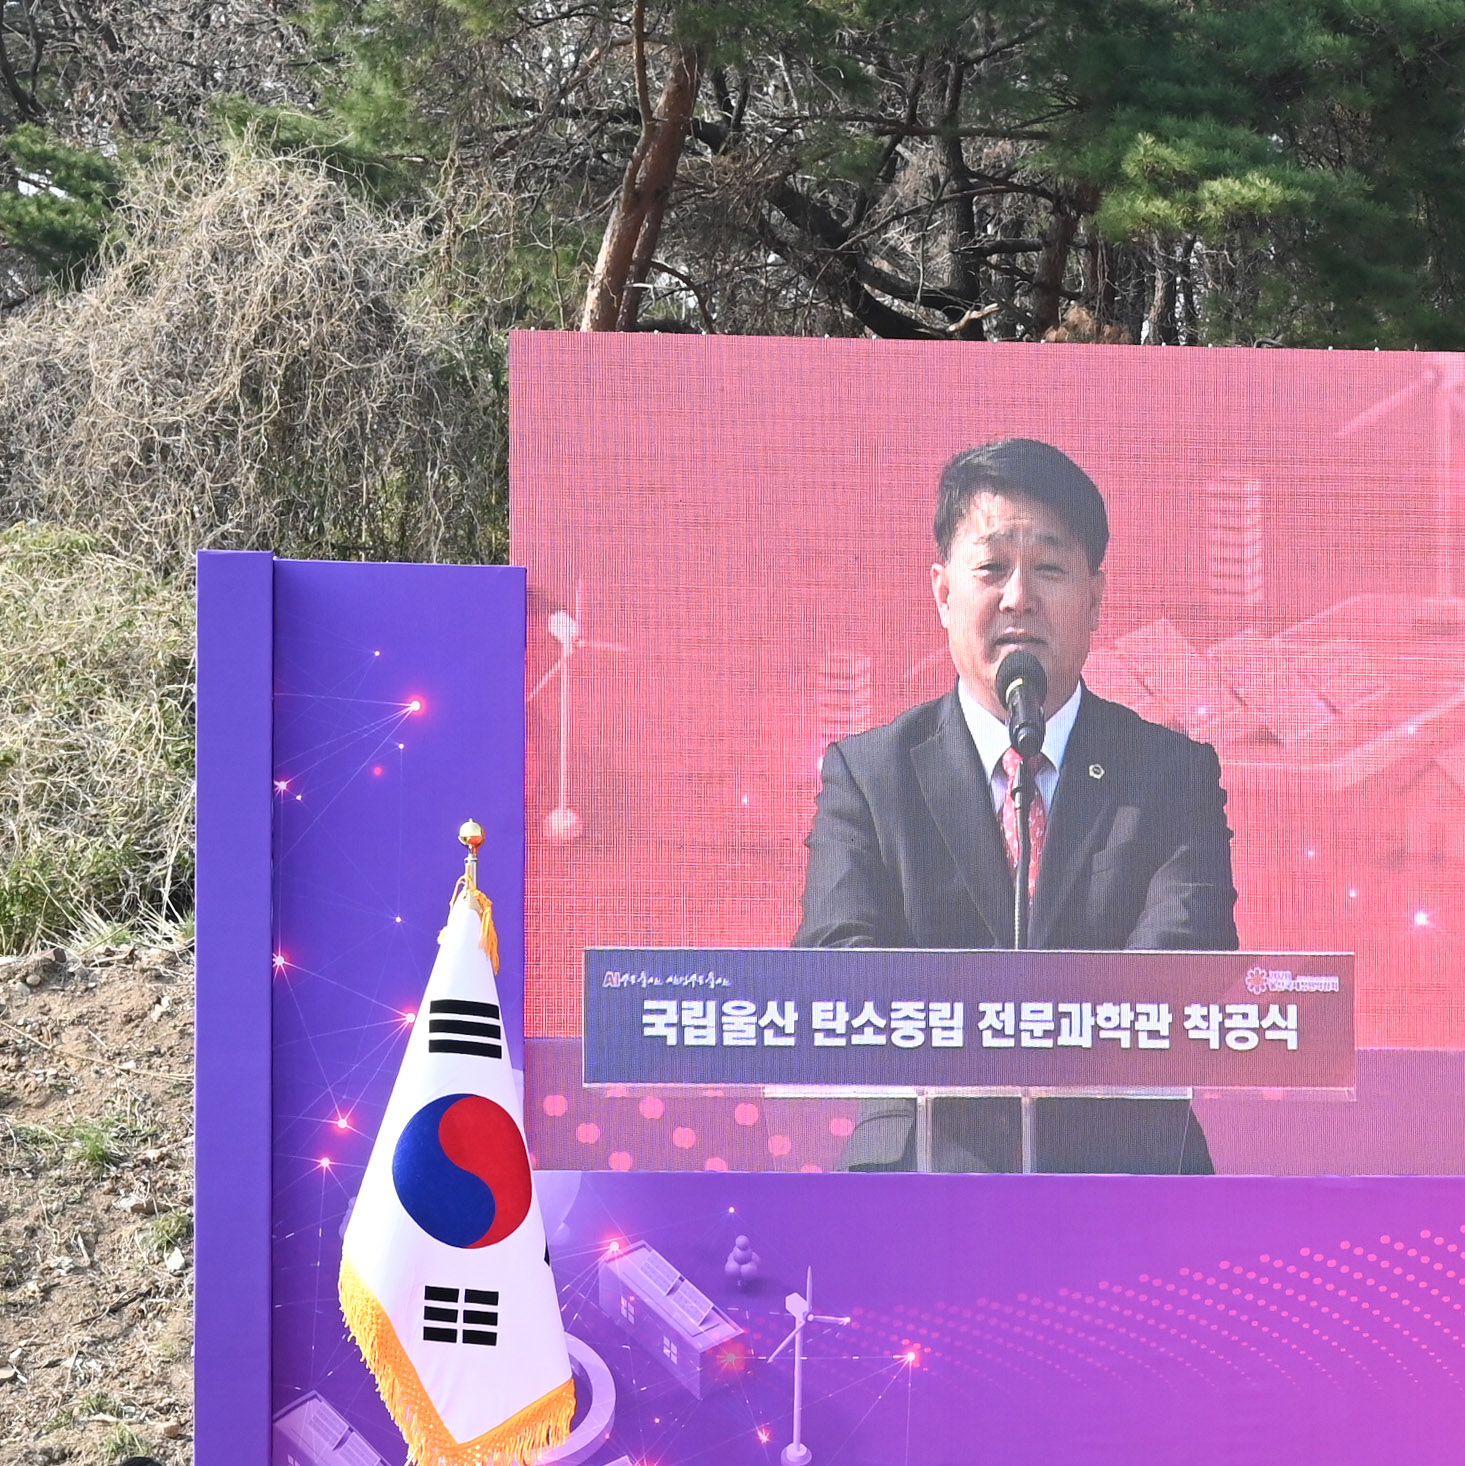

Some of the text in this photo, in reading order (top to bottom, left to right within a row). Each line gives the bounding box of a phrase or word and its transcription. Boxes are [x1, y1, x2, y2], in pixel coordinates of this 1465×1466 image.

[642, 998, 1299, 1051] 국립울산 탄소중립 전문과학관 착공식
